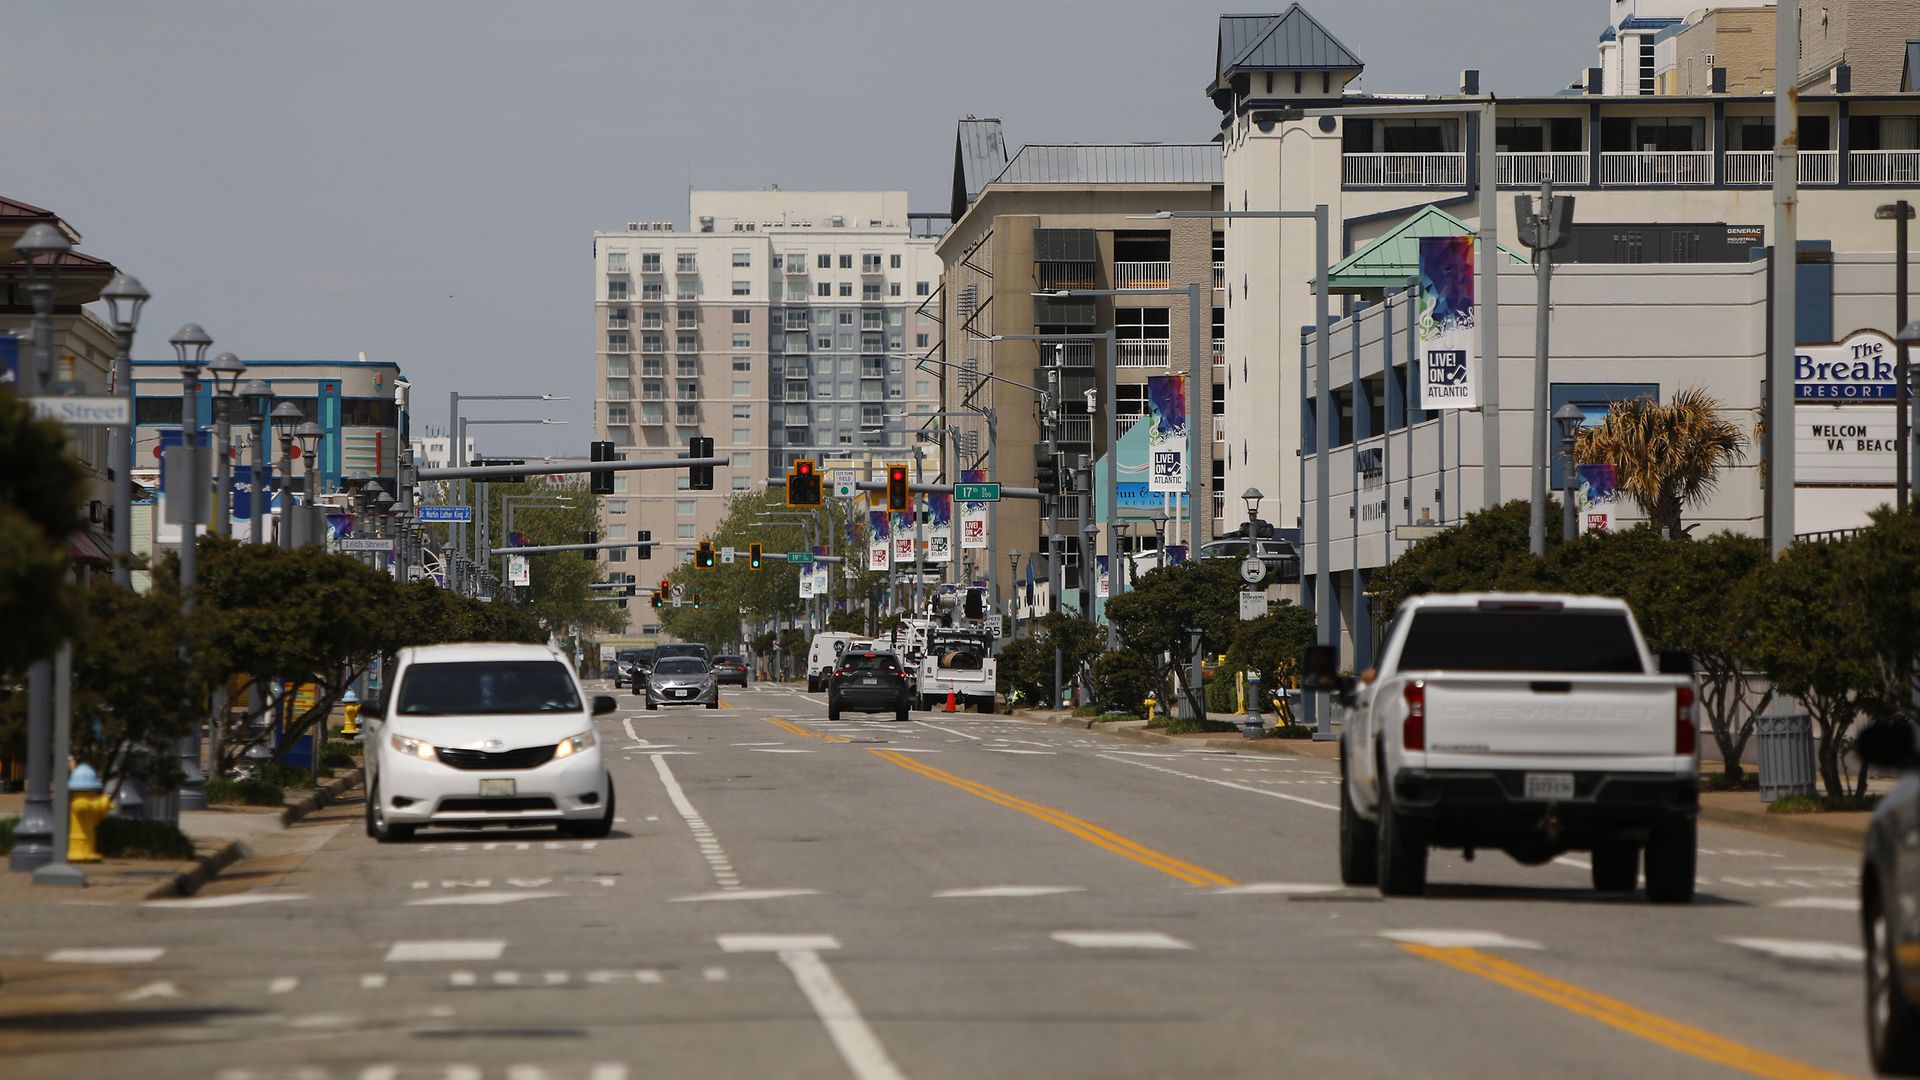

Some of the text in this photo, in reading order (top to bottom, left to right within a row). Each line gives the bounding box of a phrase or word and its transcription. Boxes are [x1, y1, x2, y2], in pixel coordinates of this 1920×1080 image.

[1851, 342, 1882, 360] The
[1430, 353, 1456, 366] LIVE!
[1430, 368, 1444, 382] ON
[1428, 386, 1468, 397] ATLANTIC
[1803, 386, 1884, 397] RESORT
[62, 402, 124, 419] Street
[1812, 426, 1866, 437] WELCOM
[1828, 440, 1844, 451] VA
[1156, 454, 1174, 463] LIVE!
[1156, 464, 1166, 474] ON
[1140, 487, 1149, 498] &
[454, 510, 463, 520] King
